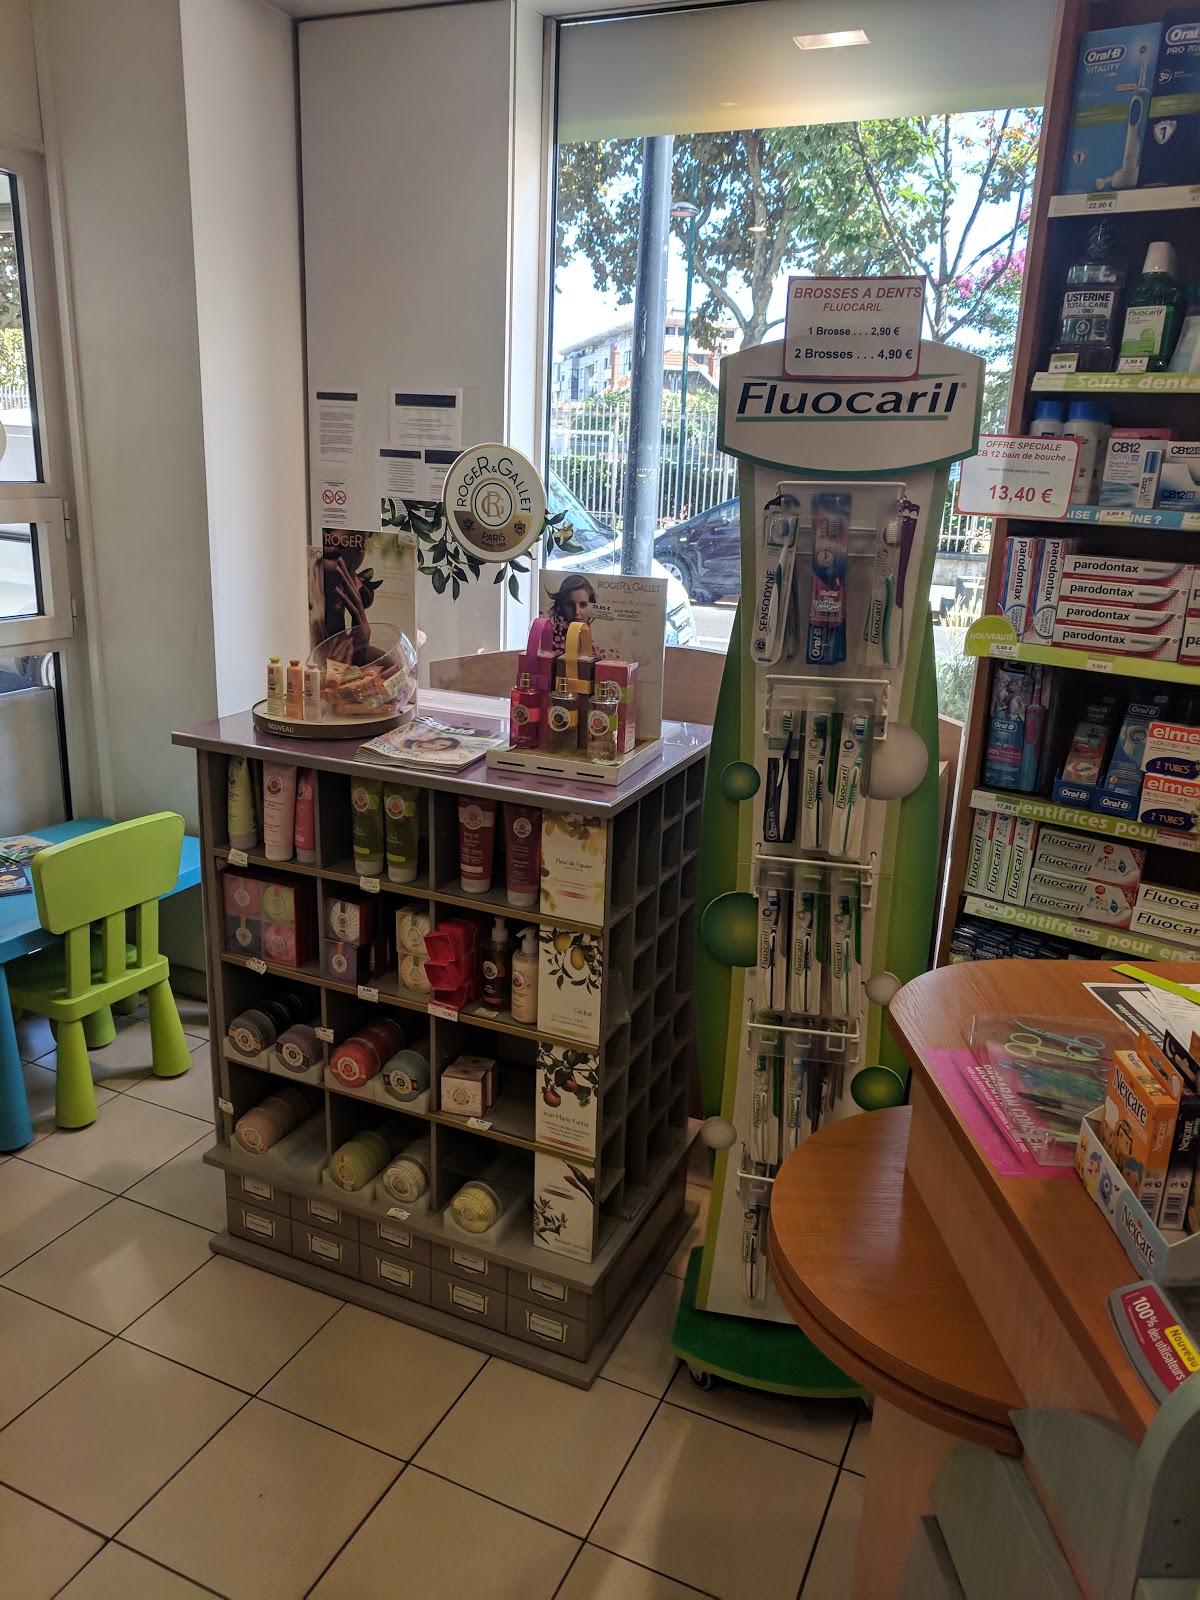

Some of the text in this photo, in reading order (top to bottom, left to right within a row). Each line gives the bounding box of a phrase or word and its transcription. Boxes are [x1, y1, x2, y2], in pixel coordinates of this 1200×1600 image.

[1086, 47, 1122, 62] Oral-B
[1167, 46, 1185, 56] PRO
[1086, 63, 1121, 75] VITALITY
[794, 286, 922, 299] BROSSES A DENTS
[1066, 292, 1111, 302] LISTERINE
[822, 302, 882, 312] FLUOCARIL
[1128, 309, 1163, 317] Fluocaril
[808, 327, 900, 337] 1 Brosse 2,90 €
[794, 348, 913, 361] 2 Brosses 4,90 €
[1074, 375, 1131, 389] Soins
[736, 382, 960, 415] Fluocaril
[986, 440, 1062, 452] OFFRE SPECIALE
[1111, 441, 1141, 454] CB12
[1171, 446, 1195, 455] CB12
[990, 450, 1000, 458] 12
[1002, 451, 1020, 459] bain
[1022, 452, 1032, 460] de
[1034, 453, 1066, 462] bouche
[989, 484, 1053, 503] 13,40 €
[1161, 491, 1186, 499] CB12
[324, 533, 363, 548] ROGER
[481, 532, 506, 543] PARIS
[1013, 540, 1028, 601] parodontax
[1044, 541, 1060, 602] parodontax
[1073, 560, 1139, 573] parodontax
[1069, 583, 1134, 598] parodontax
[758, 570, 776, 632] SENSODYNE
[1066, 605, 1130, 621] parodontax
[871, 600, 884, 644] Fluocaril
[811, 627, 823, 658] Oral-B
[969, 632, 1015, 641] NOUVEAUTÉ
[1062, 629, 1126, 645] parodontax
[267, 722, 295, 733] NOUVEAU
[994, 721, 1015, 730] Oral-B
[1156, 761, 1191, 774] 2 TUBES
[806, 769, 814, 810] Fluocaril
[836, 765, 849, 810] Fluocaril
[1061, 788, 1088, 799] Oral-B
[1102, 798, 1129, 810] Oral-B
[1017, 800, 1108, 829] entifrices
[1151, 812, 1185, 826] 2 TUBES
[1041, 833, 1096, 853] Fluocaril
[967, 834, 983, 888] Fluocaril
[986, 839, 1003, 894] Fluocaril
[1038, 853, 1092, 873] Fluocaril
[1007, 844, 1024, 900] Fluocaril
[1032, 873, 1087, 893] Fluocaril
[1030, 893, 1084, 913] Fluocaril
[761, 930, 769, 970] Fluocaril
[1106, 934, 1153, 954] pour
[1114, 1067, 1147, 1123] Nexcare
[1153, 1120, 1167, 1153] Nexcare
[1178, 1120, 1194, 1152] Nexcare
[1121, 1204, 1156, 1266] Nexcare
[1132, 1296, 1159, 1327] 100%
[1148, 1328, 1161, 1341] des
[1155, 1340, 1186, 1381] utilisateurs
[1169, 1328, 1199, 1368] Nouveau
